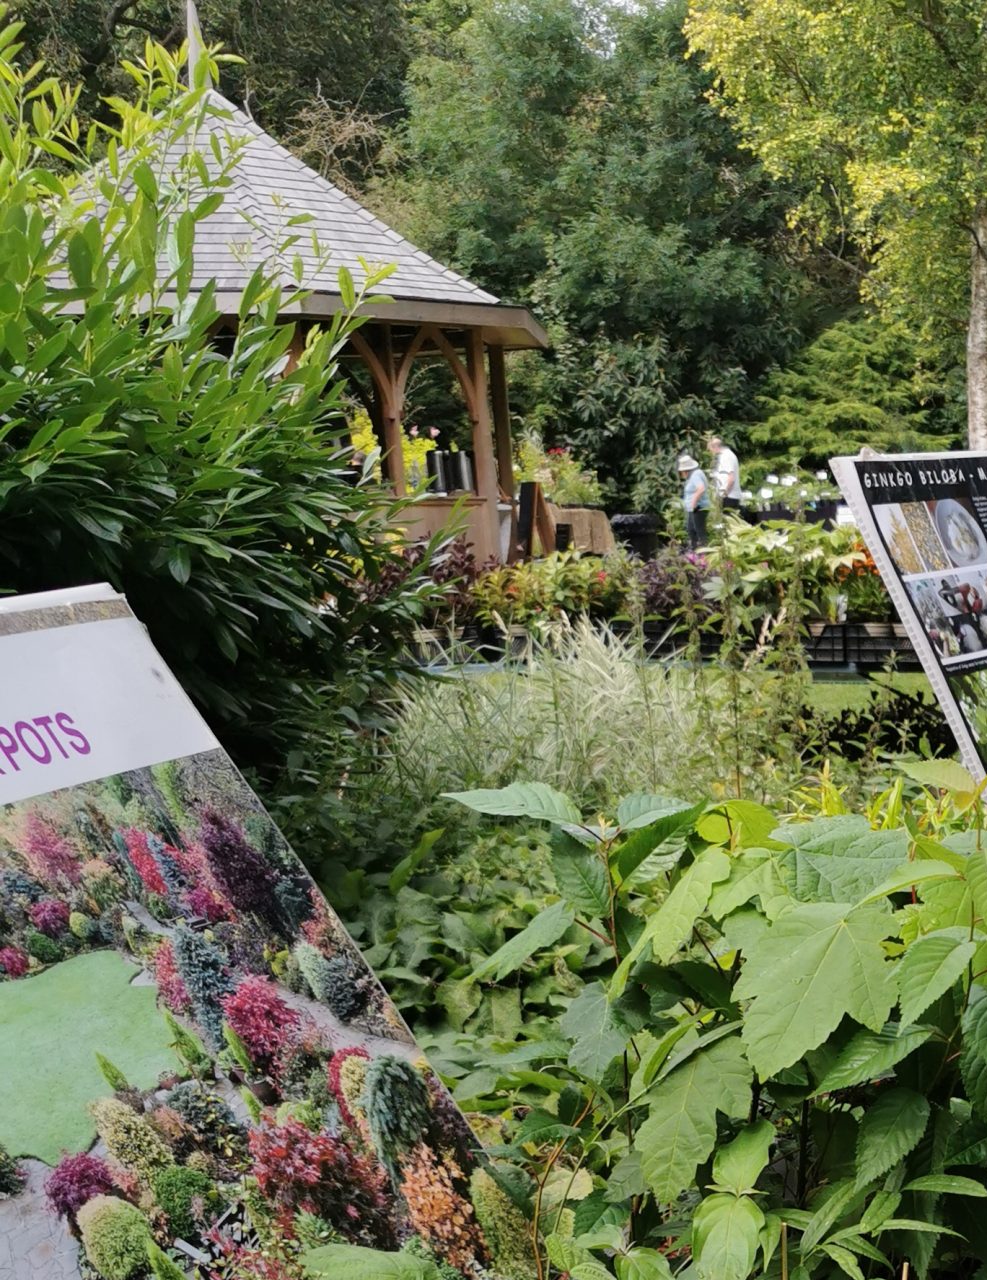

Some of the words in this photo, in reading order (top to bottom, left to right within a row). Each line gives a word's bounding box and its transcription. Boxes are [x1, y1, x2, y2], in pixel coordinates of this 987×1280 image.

[864, 471, 913, 489] GINKGO
[920, 468, 967, 486] BILOBA
[0, 712, 92, 775] POTS
